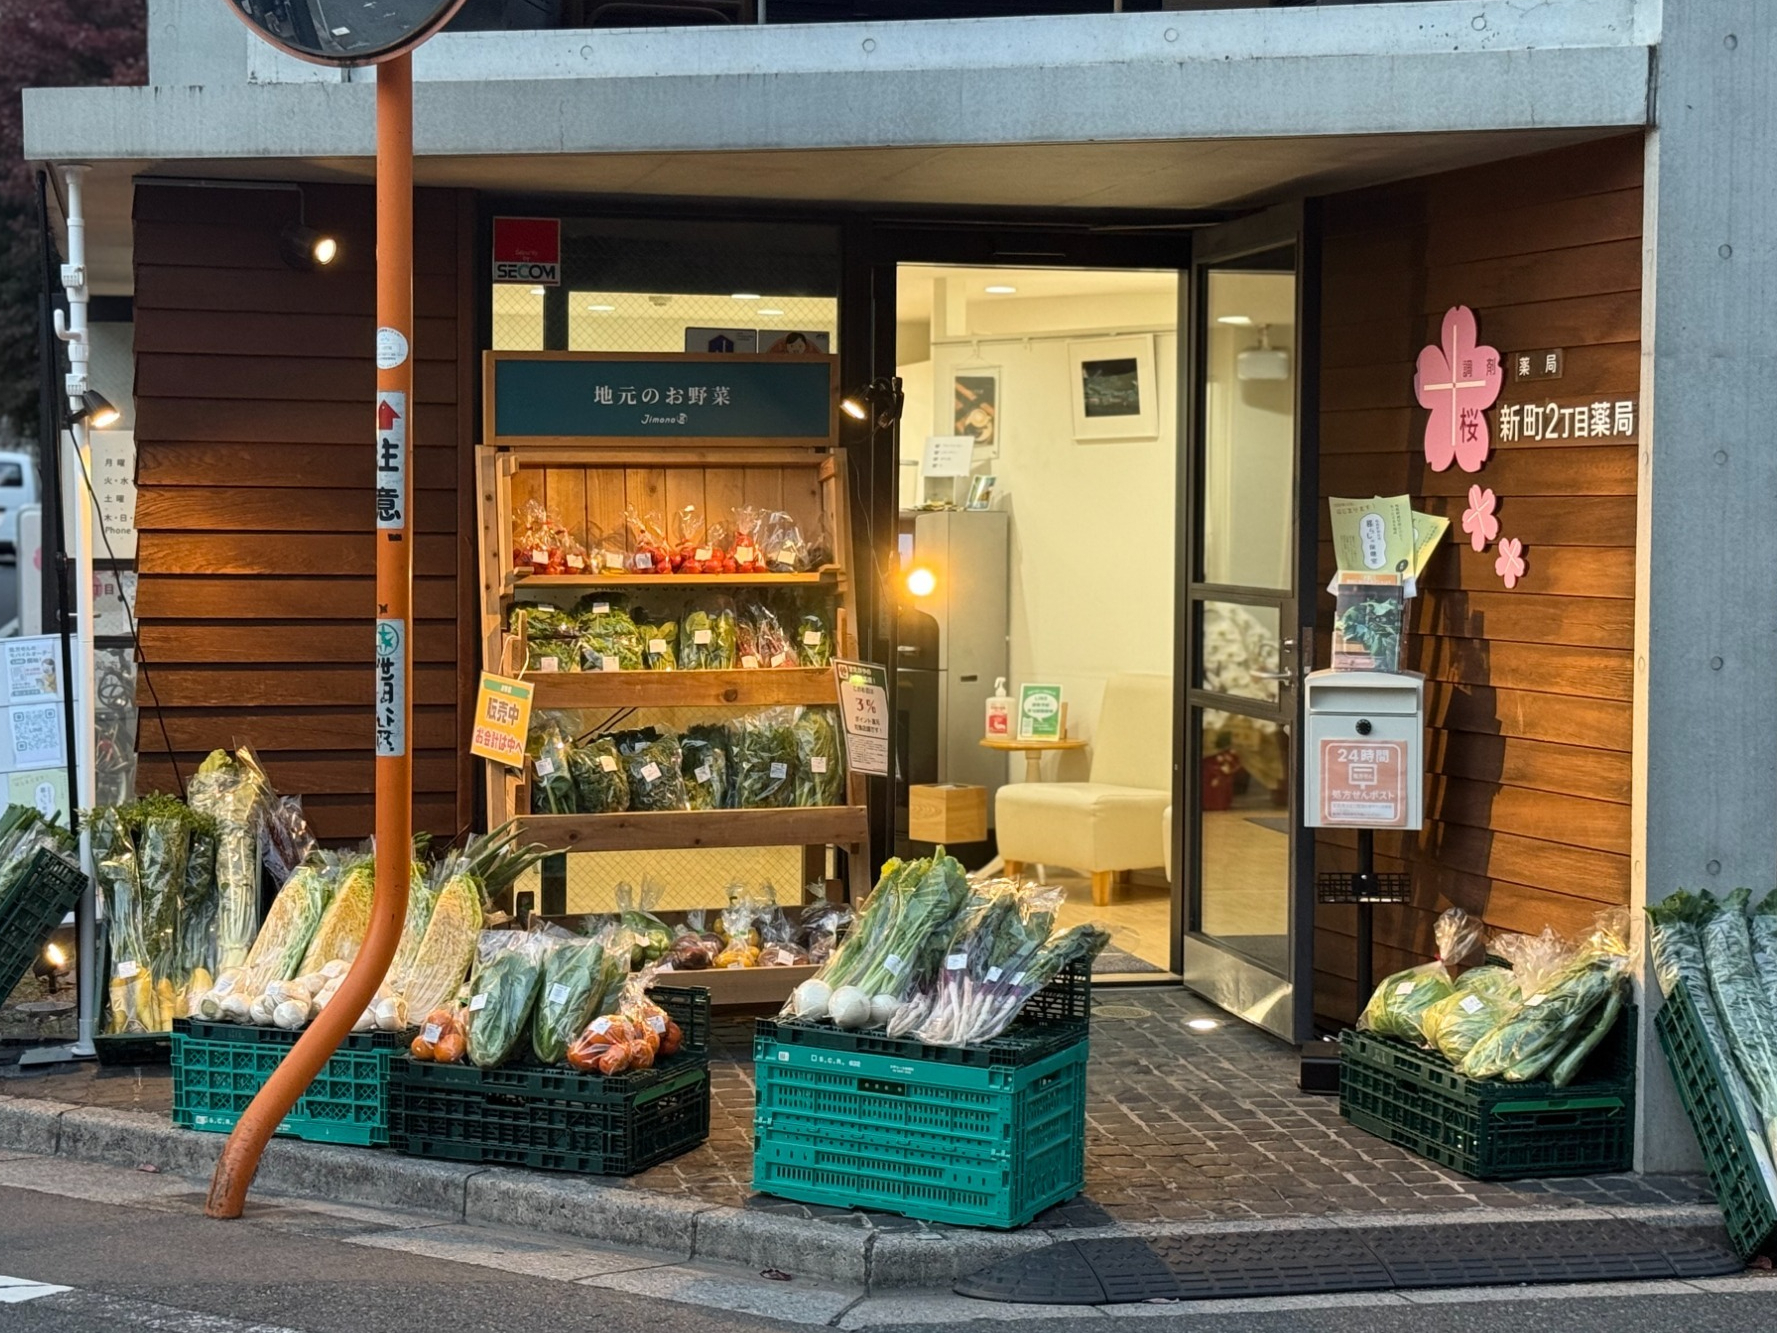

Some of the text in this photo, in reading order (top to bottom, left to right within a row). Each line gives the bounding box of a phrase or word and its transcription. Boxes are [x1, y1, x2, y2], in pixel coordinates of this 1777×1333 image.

[497, 264, 556, 279] SECOM
[594, 385, 731, 406] 地元のお野菜
[1460, 407, 1479, 443] 桜
[1500, 401, 1634, 442] 新町2丁目薬局
[105, 526, 132, 534] Phone
[486, 696, 520, 726] 販売中
[855, 697, 877, 714] 3%
[475, 728, 523, 754] お会計は中へ
[1337, 748, 1390, 763] 24時間
[1331, 790, 1395, 800] 処方せんポスト
